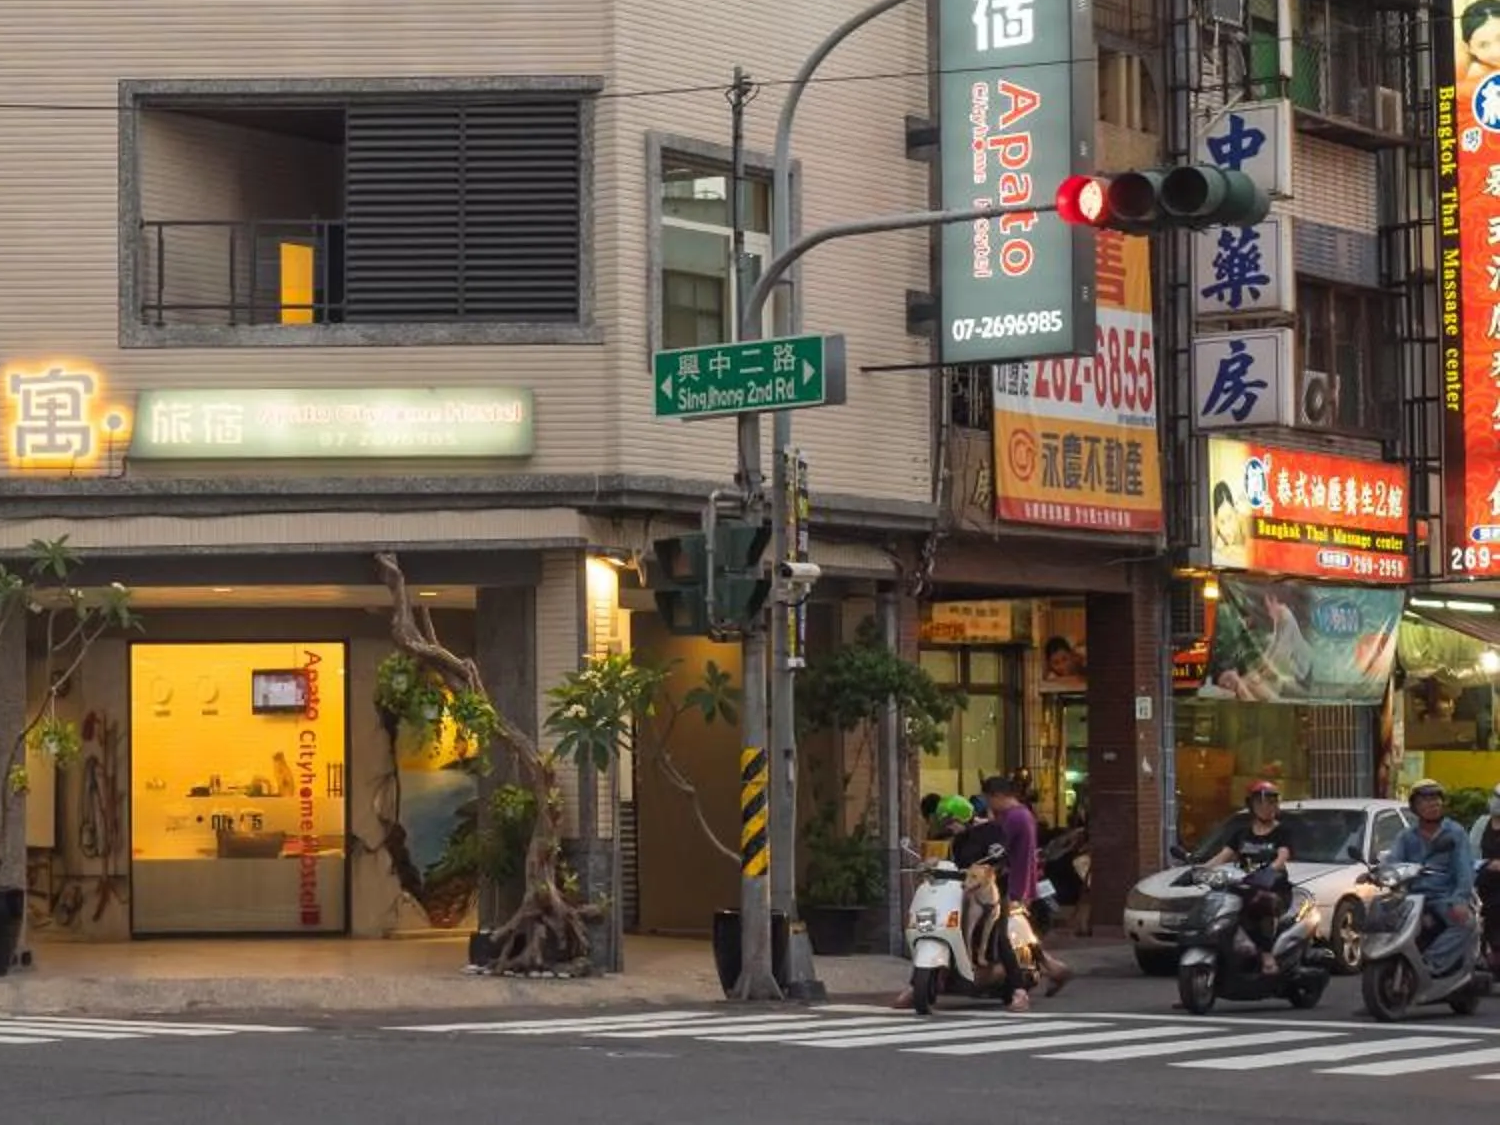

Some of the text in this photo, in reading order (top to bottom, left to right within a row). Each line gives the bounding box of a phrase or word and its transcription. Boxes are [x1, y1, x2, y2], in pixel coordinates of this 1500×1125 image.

[988, 79, 1041, 277] Apato
[1201, 114, 1270, 422] 中藥房
[1437, 85, 1463, 413] Bangkok Thai Massage center
[952, 311, 1063, 342] 07-2696985
[678, 343, 796, 382] 興中二路
[748, 379, 773, 403] 2nd
[1040, 432, 1144, 497] 永慶不動產
[303, 650, 322, 720] Apato
[296, 730, 317, 831] Cityhome
